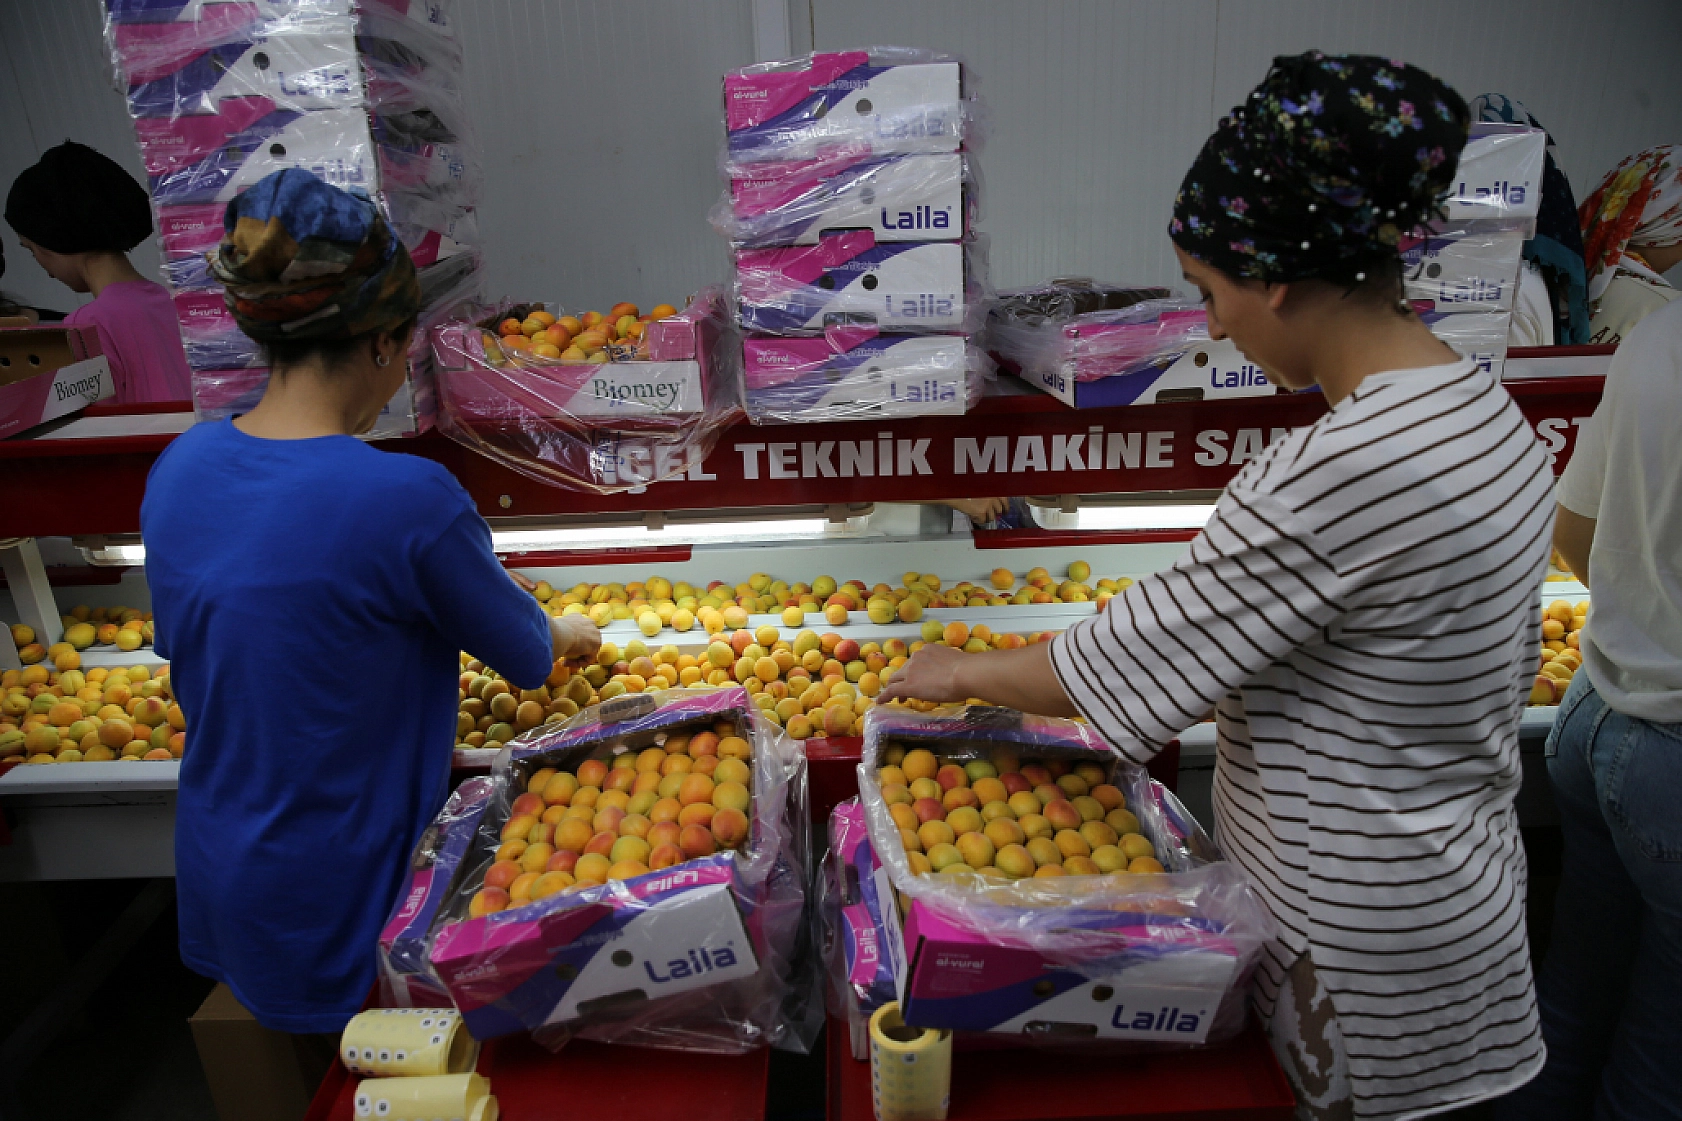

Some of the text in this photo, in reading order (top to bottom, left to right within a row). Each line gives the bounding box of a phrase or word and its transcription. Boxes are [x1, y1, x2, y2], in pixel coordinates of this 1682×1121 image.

[1459, 181, 1526, 205] Laila
[881, 205, 949, 230] Laila
[885, 294, 954, 318] Laila
[53, 374, 101, 401] Biomey
[1210, 365, 1269, 388] Laila
[592, 378, 681, 410] Biomey
[890, 380, 956, 403] Laila
[734, 431, 934, 480] TEKNİK
[953, 425, 1175, 474] MAKİNE
[860, 927, 879, 963] Laila
[643, 947, 738, 983] Laila
[1111, 1004, 1199, 1032] Laila
